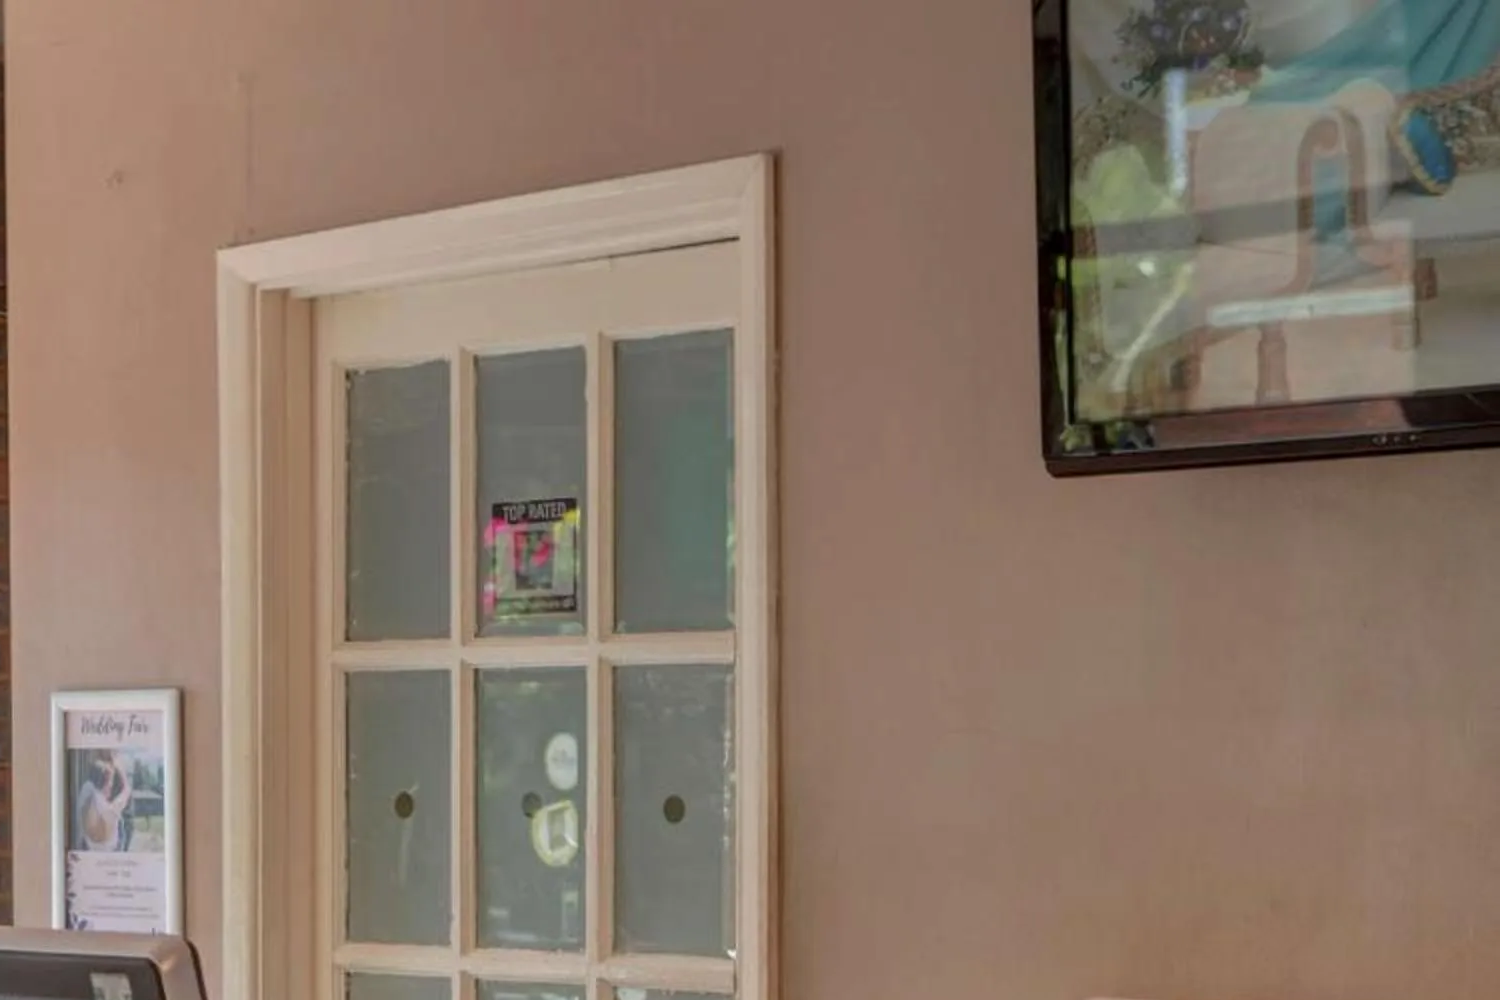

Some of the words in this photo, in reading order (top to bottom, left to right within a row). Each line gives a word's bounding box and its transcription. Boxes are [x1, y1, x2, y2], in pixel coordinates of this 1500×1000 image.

[502, 504, 526, 521] TOP
[528, 501, 567, 519] RATED
[81, 713, 124, 741] Wedding
[127, 713, 149, 736] Fair
